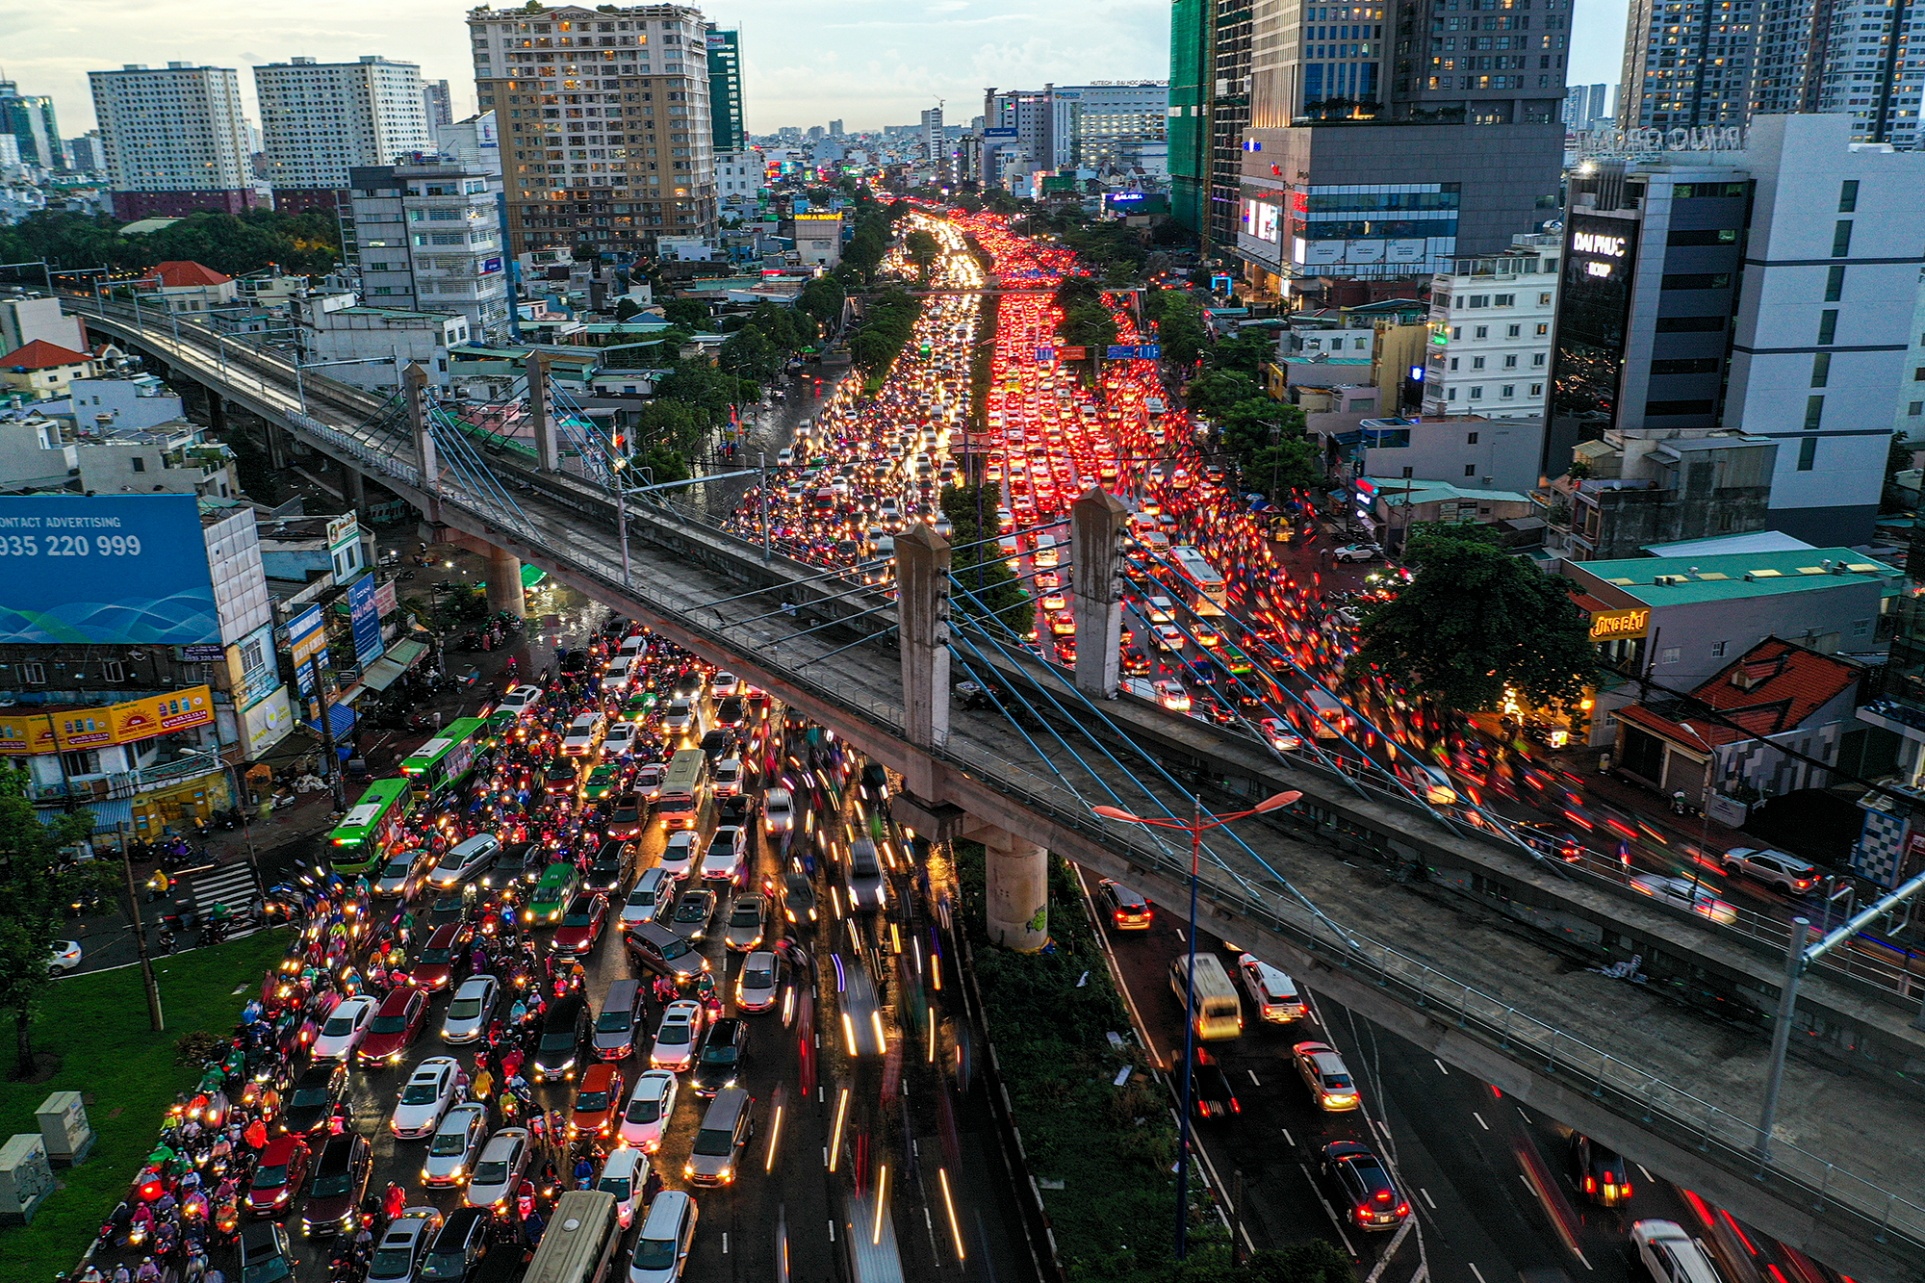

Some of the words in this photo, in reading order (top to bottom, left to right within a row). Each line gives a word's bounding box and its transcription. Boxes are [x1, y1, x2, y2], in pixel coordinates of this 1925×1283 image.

[558, 12, 595, 20] DAEWON
[46, 517, 122, 528] ADVERTISING
[45, 535, 90, 556] 220
[96, 535, 142, 556] 999
